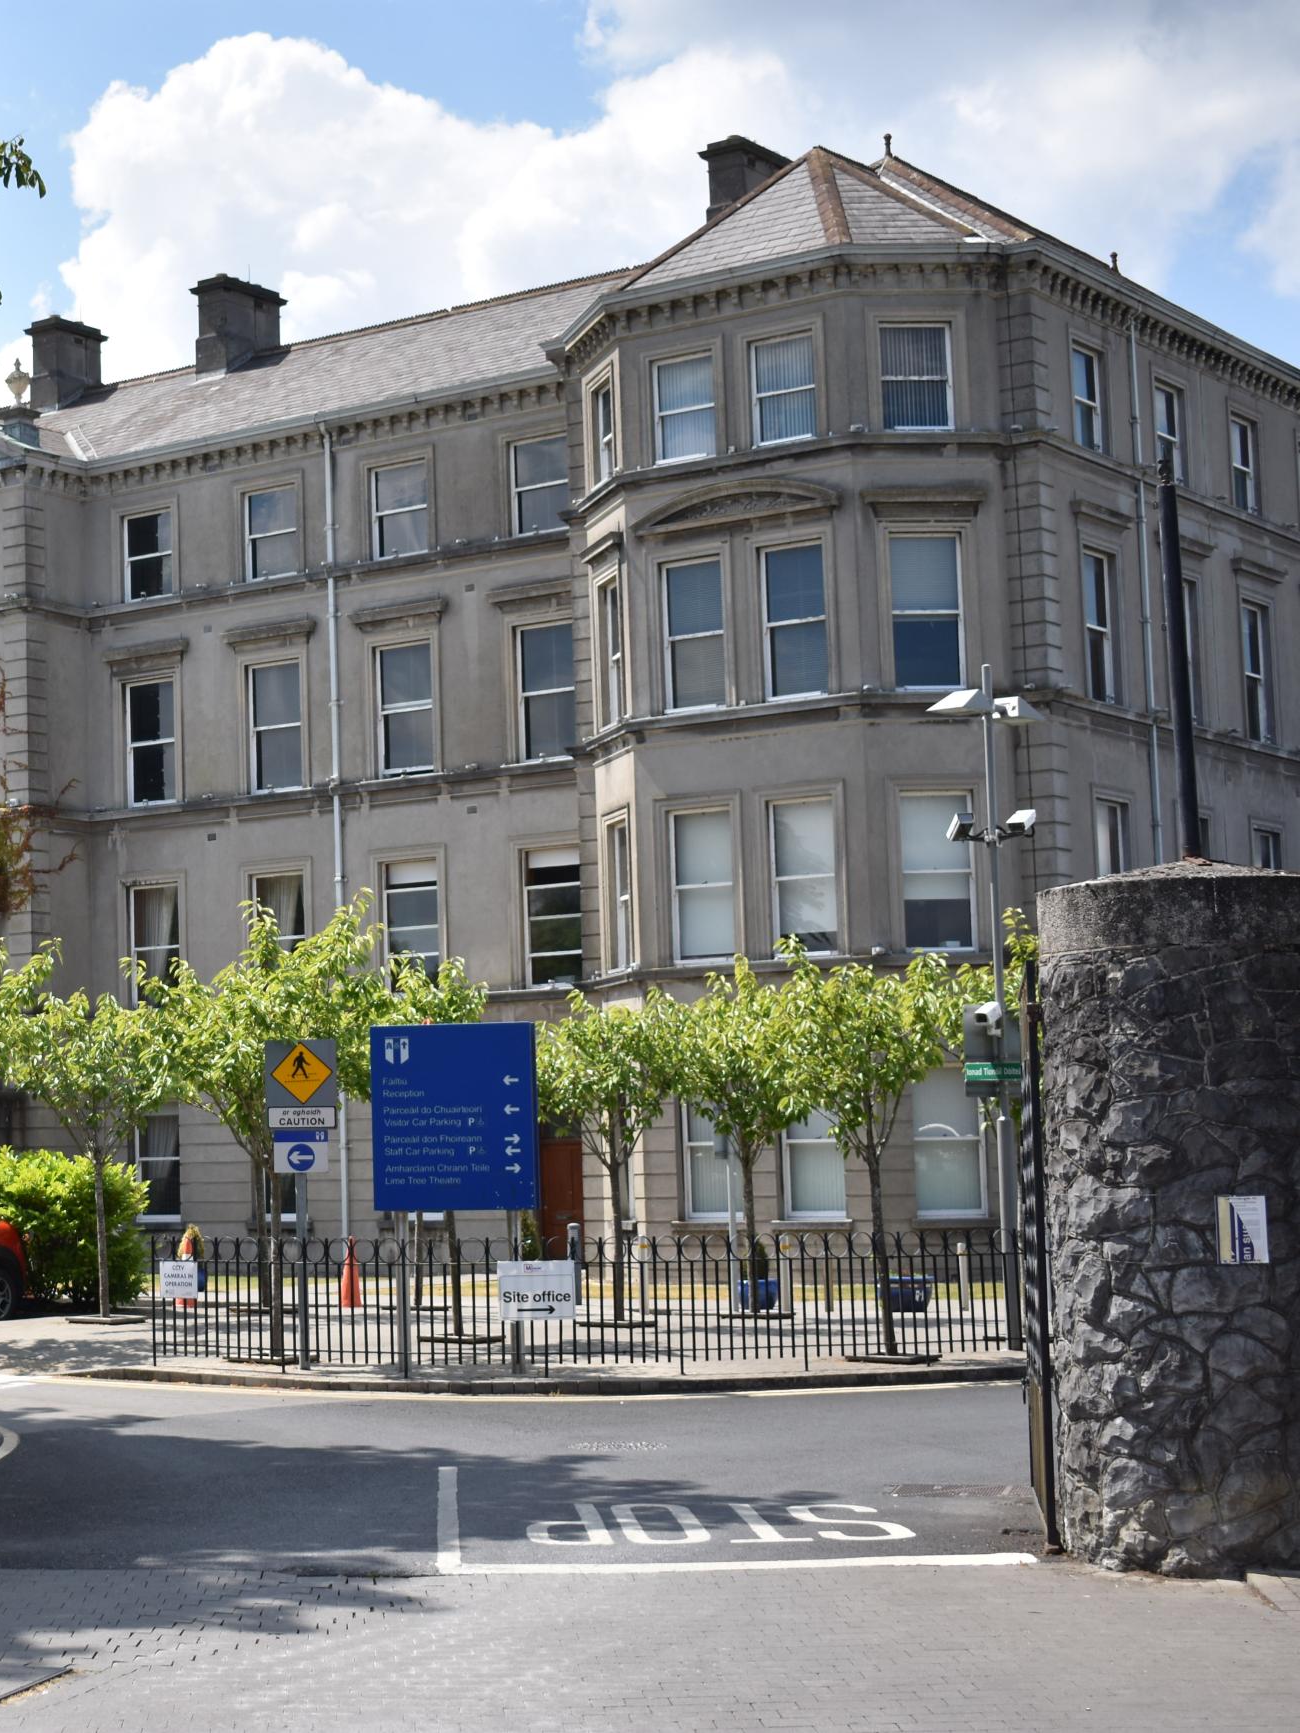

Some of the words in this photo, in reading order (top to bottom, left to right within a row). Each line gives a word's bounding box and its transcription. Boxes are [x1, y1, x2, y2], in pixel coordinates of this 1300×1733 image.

[382, 1089, 425, 1099] Reception
[422, 1106, 432, 1114] do
[279, 1117, 325, 1126] CAUTION
[384, 1119, 410, 1127] Visitor
[412, 1118, 427, 1126] Car
[429, 1118, 462, 1128] Parking
[422, 1135, 438, 1143] don
[440, 1134, 482, 1143] Fhoireann
[384, 1147, 404, 1156] Staff
[406, 1147, 422, 1156] Car
[424, 1146, 455, 1157] Parking
[437, 1163, 469, 1172] Chrann
[471, 1163, 490, 1172] Teile
[385, 1176, 405, 1185] Lime
[407, 1176, 427, 1185] Tree
[429, 1175, 462, 1184] Theatre
[502, 1291, 529, 1303] Site
[532, 1290, 571, 1303] office
[525, 1502, 917, 1546] STOP
